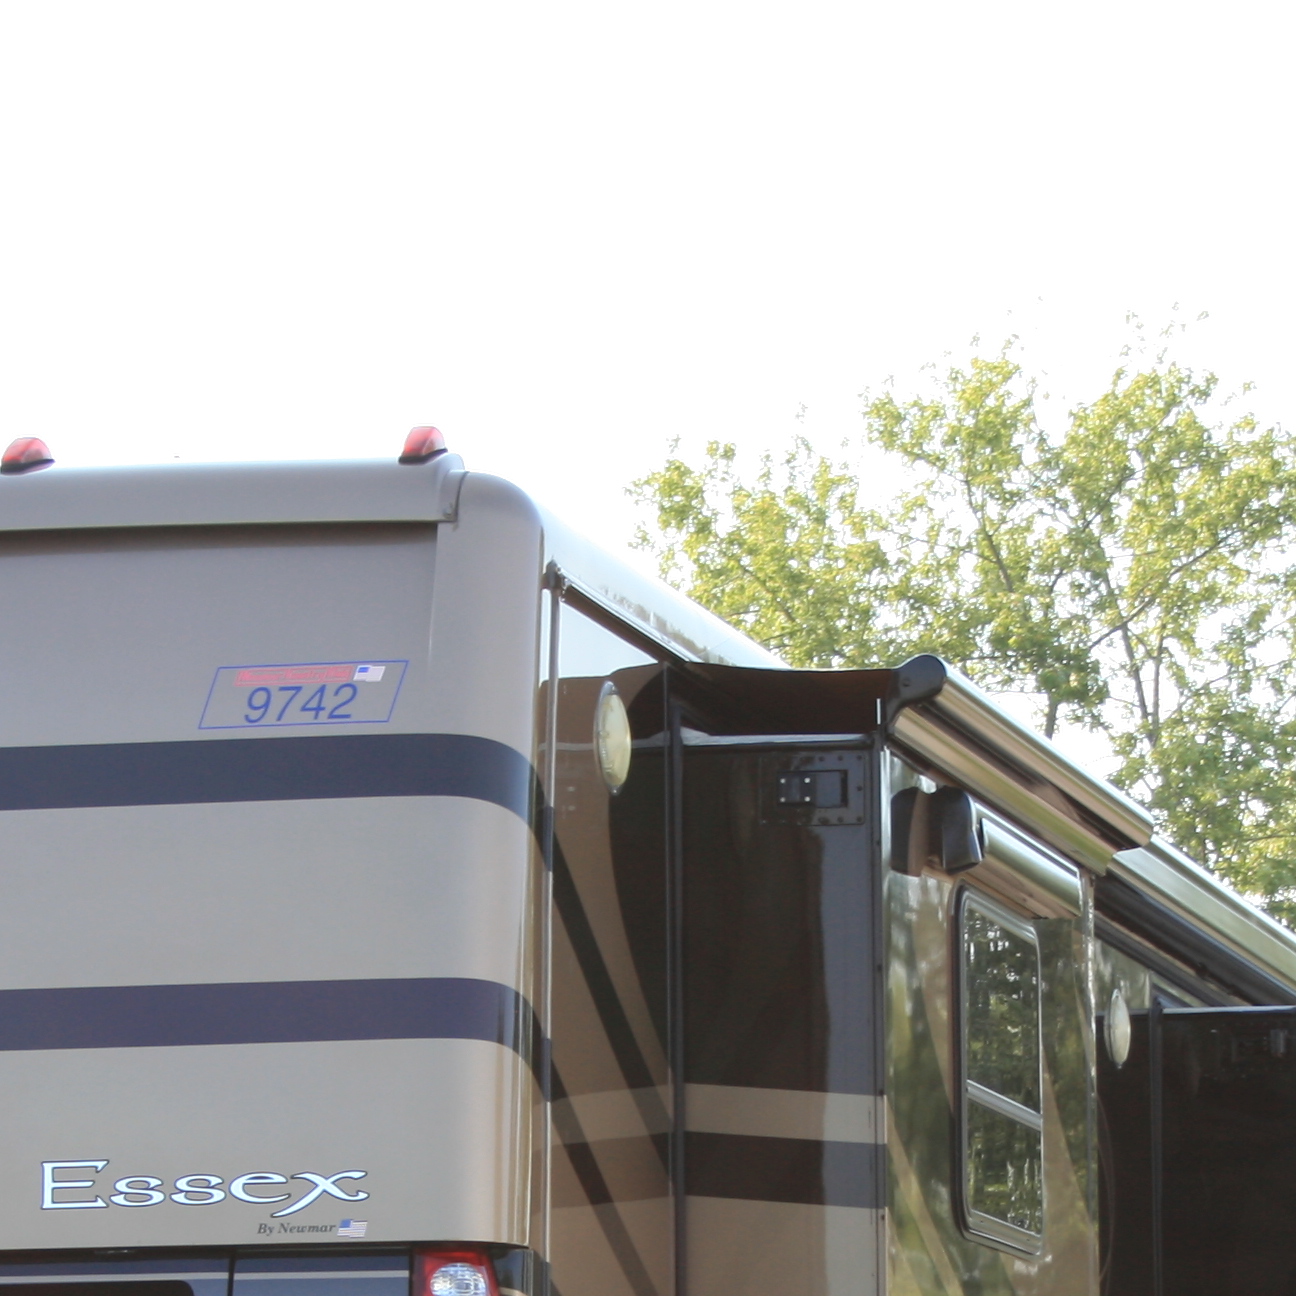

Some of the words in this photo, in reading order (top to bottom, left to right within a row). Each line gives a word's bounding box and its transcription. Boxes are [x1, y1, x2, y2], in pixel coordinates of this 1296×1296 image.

[244, 683, 358, 724] 9742
[39, 1158, 370, 1218] Essex
[257, 1222, 274, 1236] By
[278, 1222, 336, 1235] Newmar
